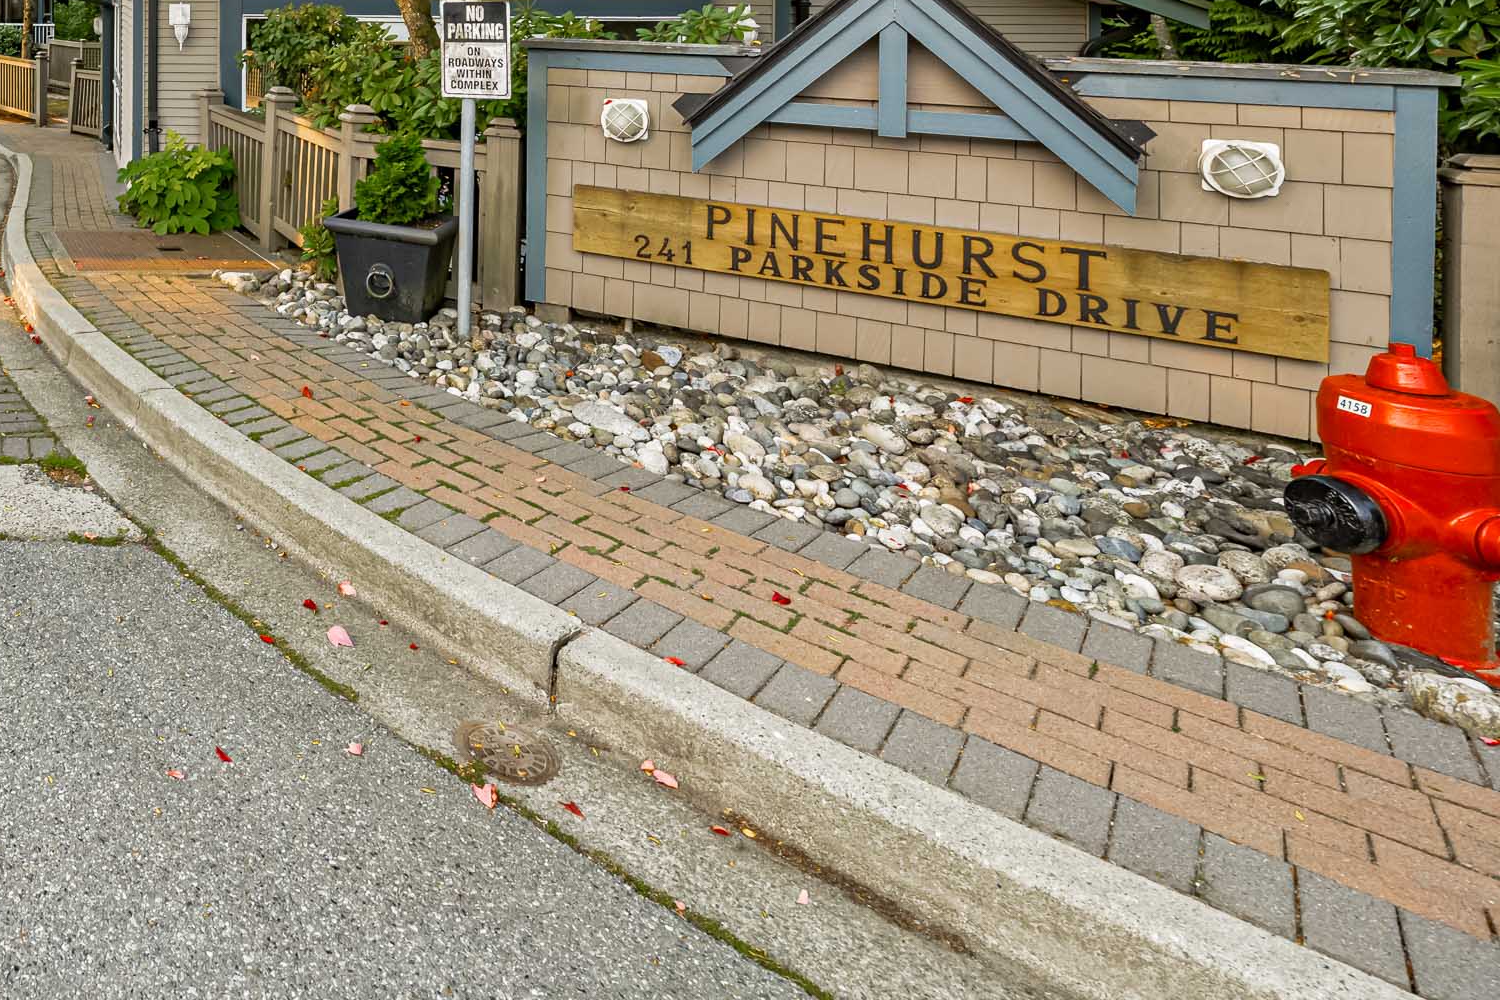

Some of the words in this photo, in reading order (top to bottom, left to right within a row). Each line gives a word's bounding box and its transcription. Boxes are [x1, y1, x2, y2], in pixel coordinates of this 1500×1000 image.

[465, 5, 485, 22] NO
[447, 22, 504, 40] PARKING
[467, 47, 481, 56] ON
[448, 58, 504, 68] ROADWAYS
[456, 69, 492, 79] WITHIN
[450, 80, 499, 90] COMPLEX
[706, 204, 1107, 292] PINEHURST
[634, 234, 692, 265] 241
[728, 245, 988, 307] PARKSIDE
[1036, 287, 1239, 344] DRIVE
[1339, 399, 1368, 415] 4158
